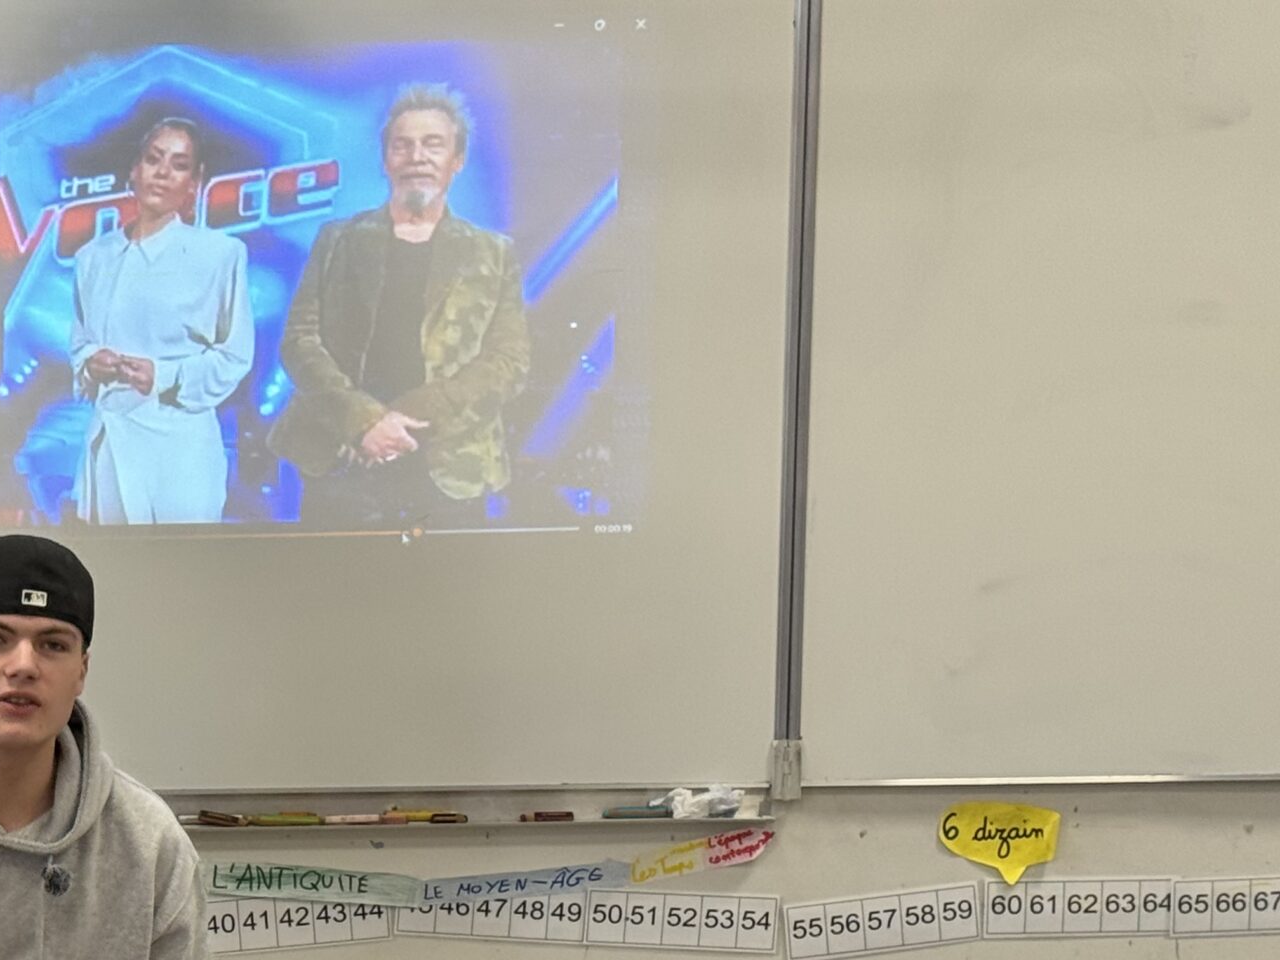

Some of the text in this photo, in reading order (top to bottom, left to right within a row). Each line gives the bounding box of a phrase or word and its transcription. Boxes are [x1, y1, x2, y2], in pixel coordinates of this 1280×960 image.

[60, 174, 117, 199] the
[942, 812, 1045, 858] 6 dizain
[423, 883, 443, 900] LE
[992, 893, 1171, 914] 60 61 62 63 64
[1178, 891, 1280, 914] 65 66 67
[208, 903, 383, 933] 40 41 42 43 44
[477, 899, 507, 917] 47
[514, 901, 544, 920] 48
[551, 903, 581, 922] 49
[593, 904, 770, 930] 50 51 52 53 54
[793, 900, 972, 939] 55 56 57 58 59
